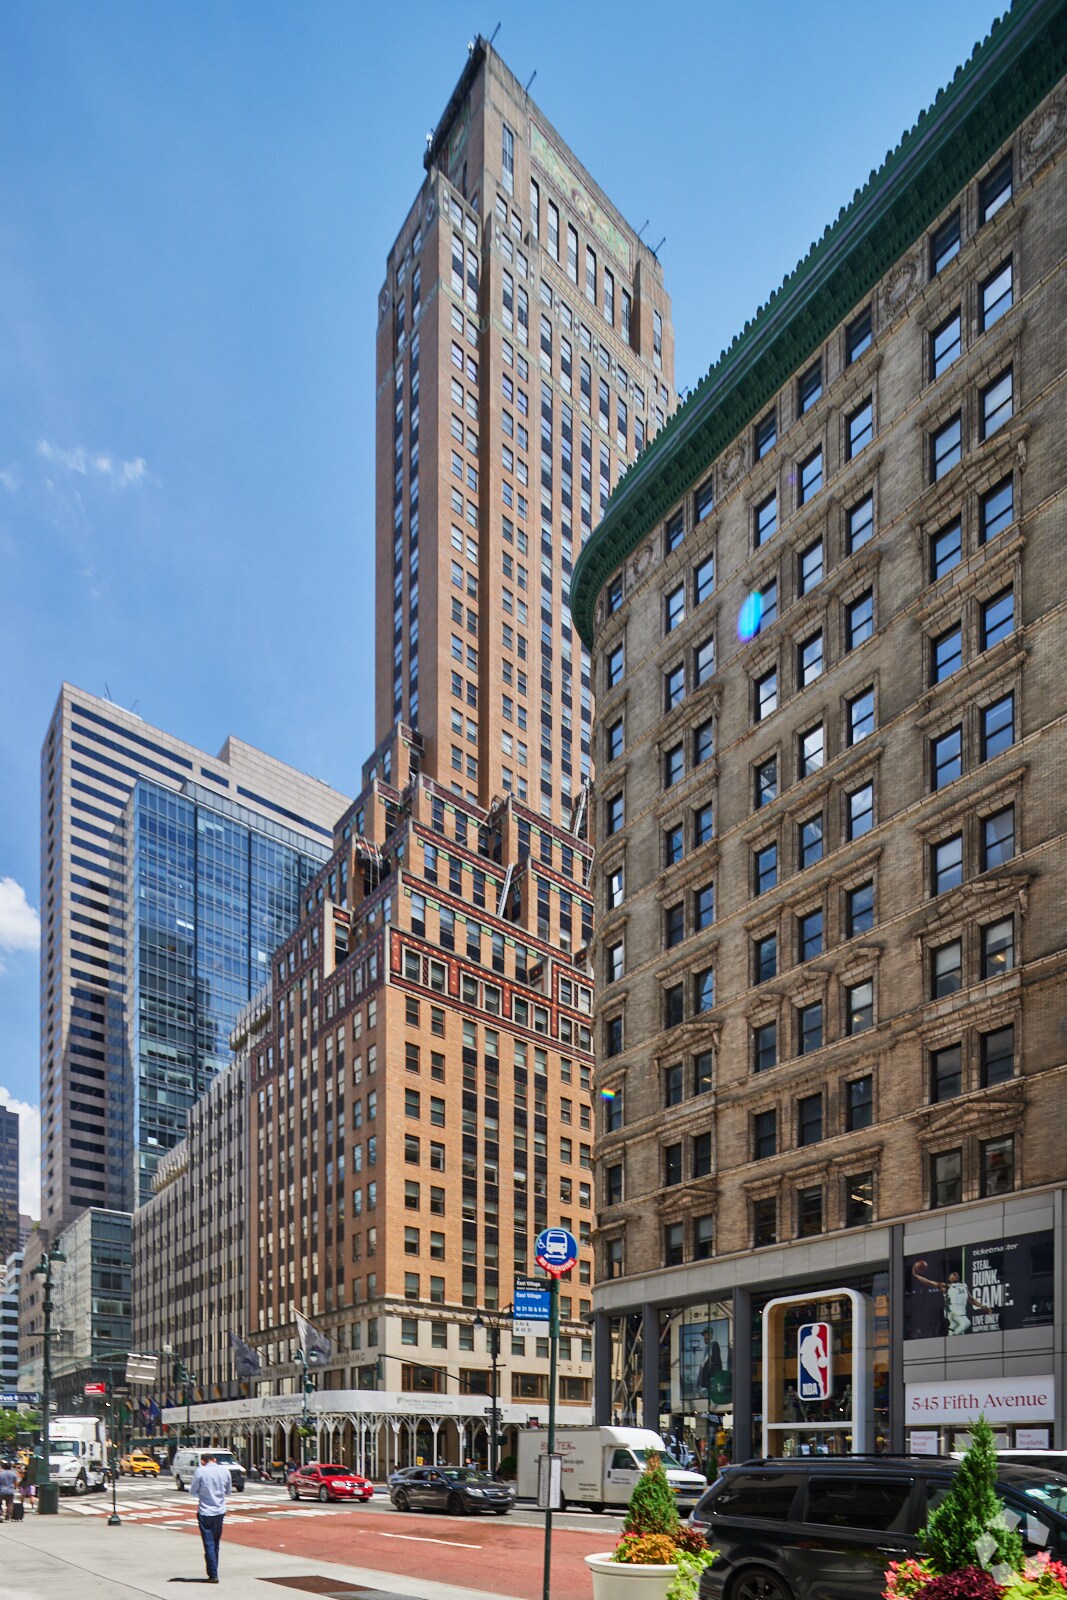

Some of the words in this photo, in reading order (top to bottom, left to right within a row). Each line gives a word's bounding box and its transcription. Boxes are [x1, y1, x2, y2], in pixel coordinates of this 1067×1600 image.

[546, 1259, 574, 1271] STANDING
[972, 1259, 992, 1271] STEAL.
[972, 1269, 1001, 1287] DUNK.
[526, 1292, 542, 1300] Village
[972, 1283, 1014, 1310] GAME.
[972, 1315, 984, 1326] LIVE
[984, 1313, 1000, 1324] ONLY
[802, 1382, 818, 1396] NBA
[911, 1397, 939, 1411] 545
[943, 1394, 979, 1410] Fifth
[983, 1393, 1048, 1408] Avenue
